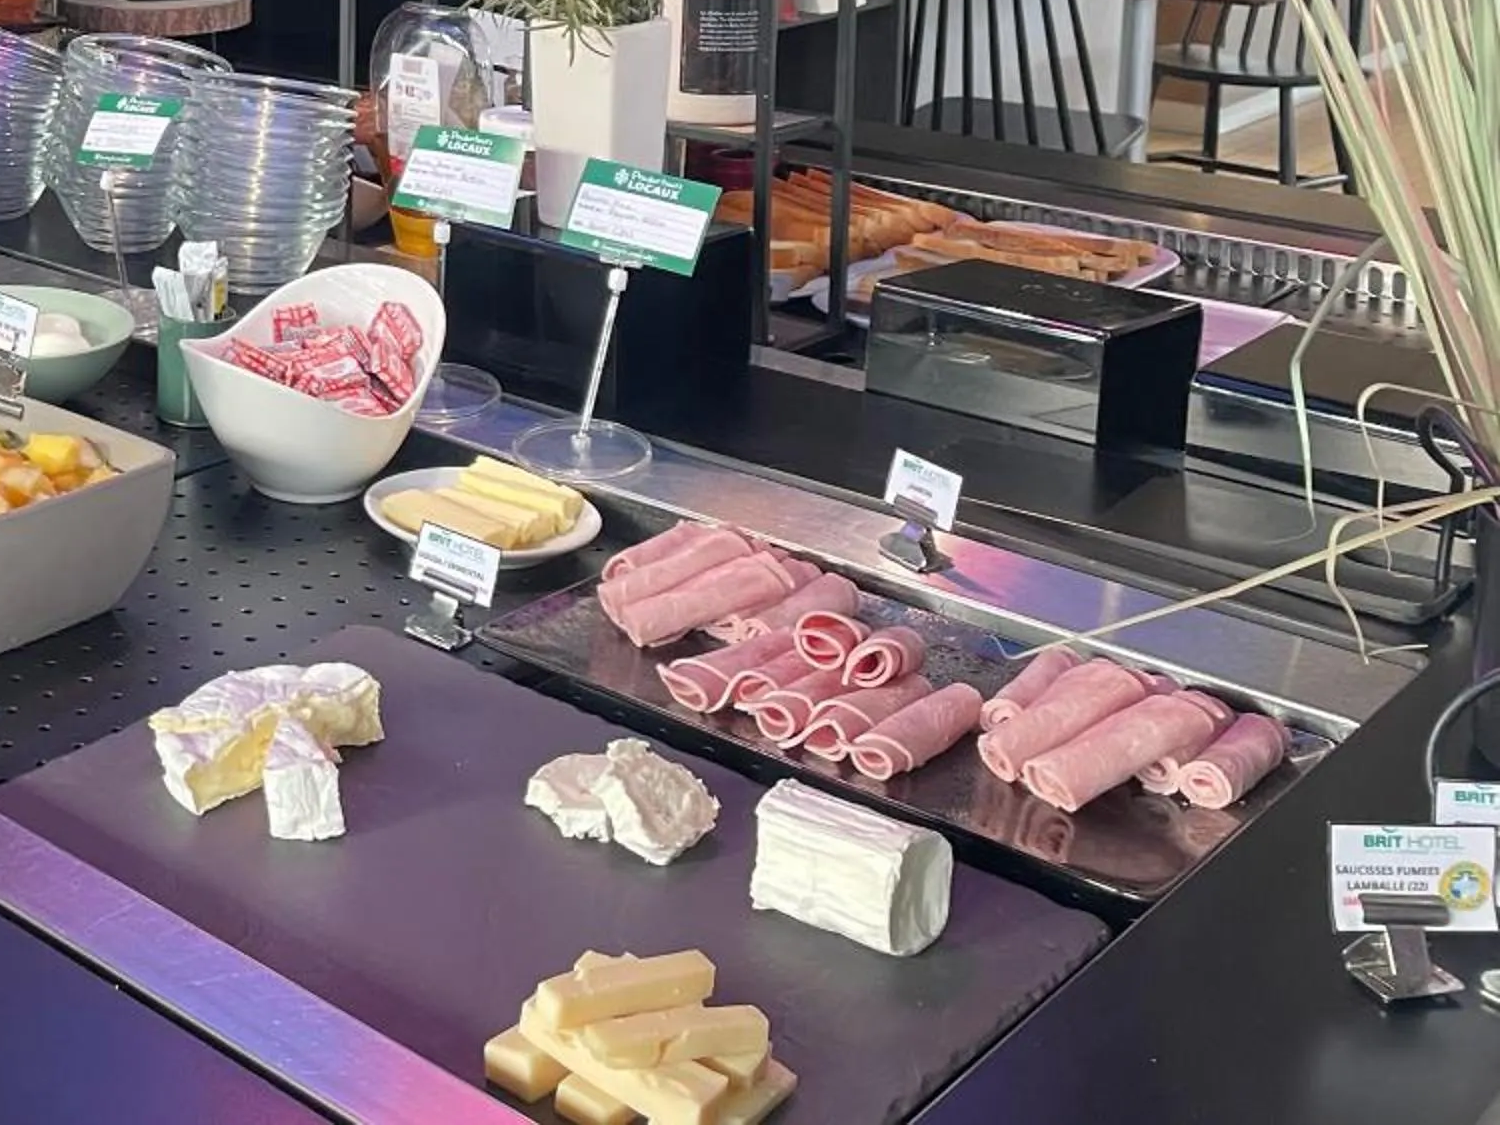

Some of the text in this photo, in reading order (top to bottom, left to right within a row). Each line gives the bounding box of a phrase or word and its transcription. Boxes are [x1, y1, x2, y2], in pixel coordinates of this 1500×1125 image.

[447, 140, 491, 156] LOCAUX
[628, 181, 681, 201] LOCAUX
[1454, 790, 1496, 804] BRIT
[1363, 834, 1464, 850] BRIT HOTEL
[1335, 864, 1394, 876] SAUCISSES
[1346, 880, 1405, 892] LAMBALLE
